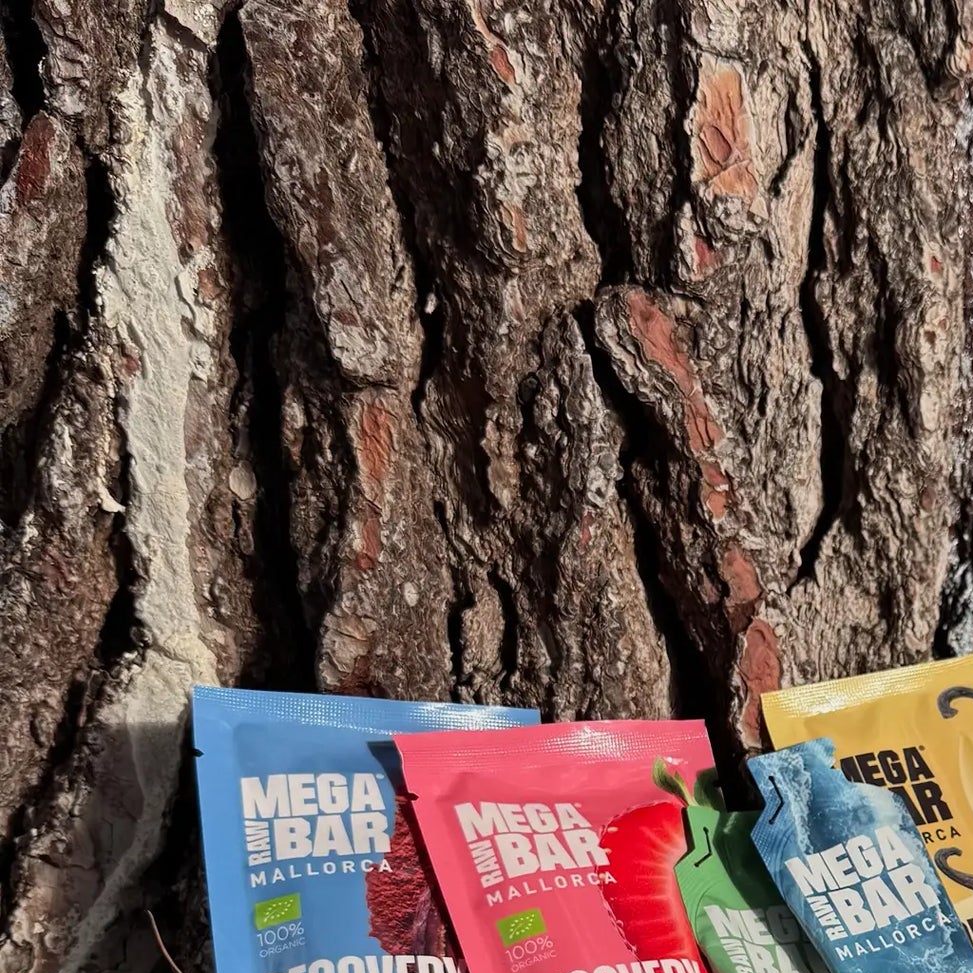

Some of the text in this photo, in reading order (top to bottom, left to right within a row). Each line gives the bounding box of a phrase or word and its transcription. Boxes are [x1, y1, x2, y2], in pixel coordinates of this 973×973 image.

[240, 773, 386, 819] MEGA
[244, 812, 391, 867] RAW BAR
[453, 801, 593, 844] MEGA
[250, 858, 394, 889] MALLORCA
[468, 828, 611, 889] RAW BAR
[784, 824, 914, 897] MEGA
[485, 871, 618, 908] MALLORCA
[806, 863, 942, 942] RAW BAR
[257, 922, 305, 947] 100%
[703, 904, 812, 946] MEG
[834, 914, 953, 962] MALLORCA
[259, 936, 307, 959] ORGANIC
[505, 935, 555, 964] 100%
[511, 950, 559, 973] ORGANIC
